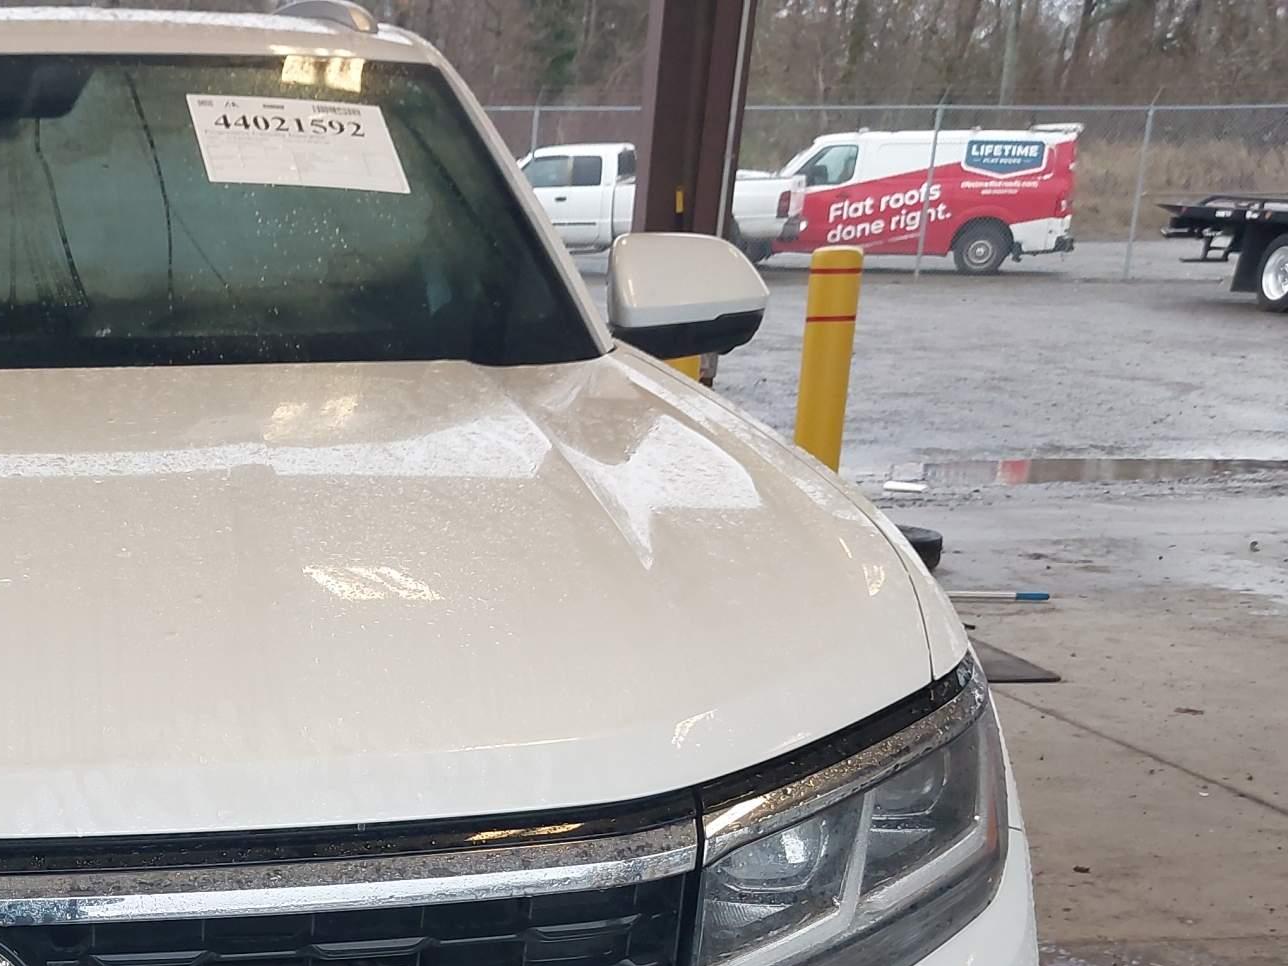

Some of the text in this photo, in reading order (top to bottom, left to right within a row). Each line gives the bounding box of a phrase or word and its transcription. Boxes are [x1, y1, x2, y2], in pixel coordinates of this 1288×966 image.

[214, 113, 366, 138] 44021592
[970, 143, 1040, 158] LIFETIME
[828, 181, 943, 223] Flat roofs
[826, 219, 886, 243] done
